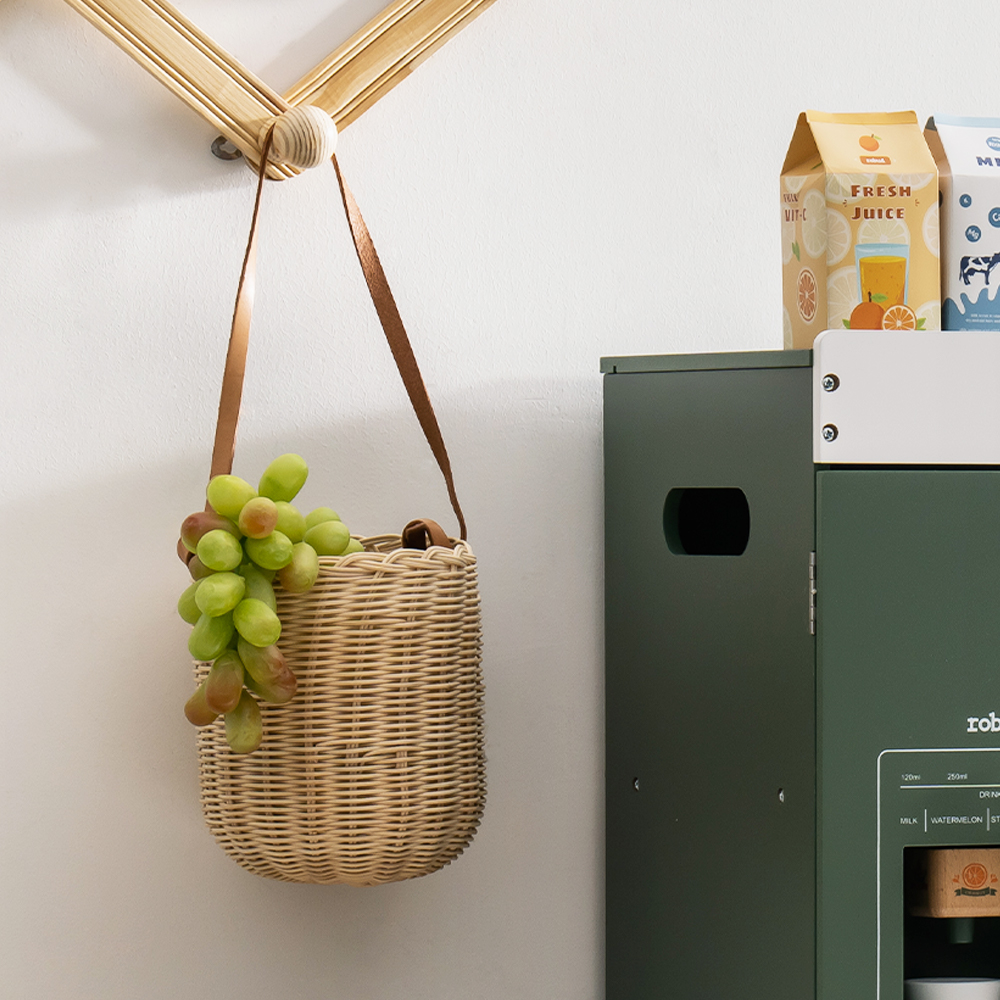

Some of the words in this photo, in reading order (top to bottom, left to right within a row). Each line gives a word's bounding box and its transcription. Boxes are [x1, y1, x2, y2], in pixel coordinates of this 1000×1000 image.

[784, 208, 807, 222] VIT-C
[947, 772, 968, 781] 250ml
[900, 817, 918, 825] MILK
[930, 815, 983, 825] WATERMELON
